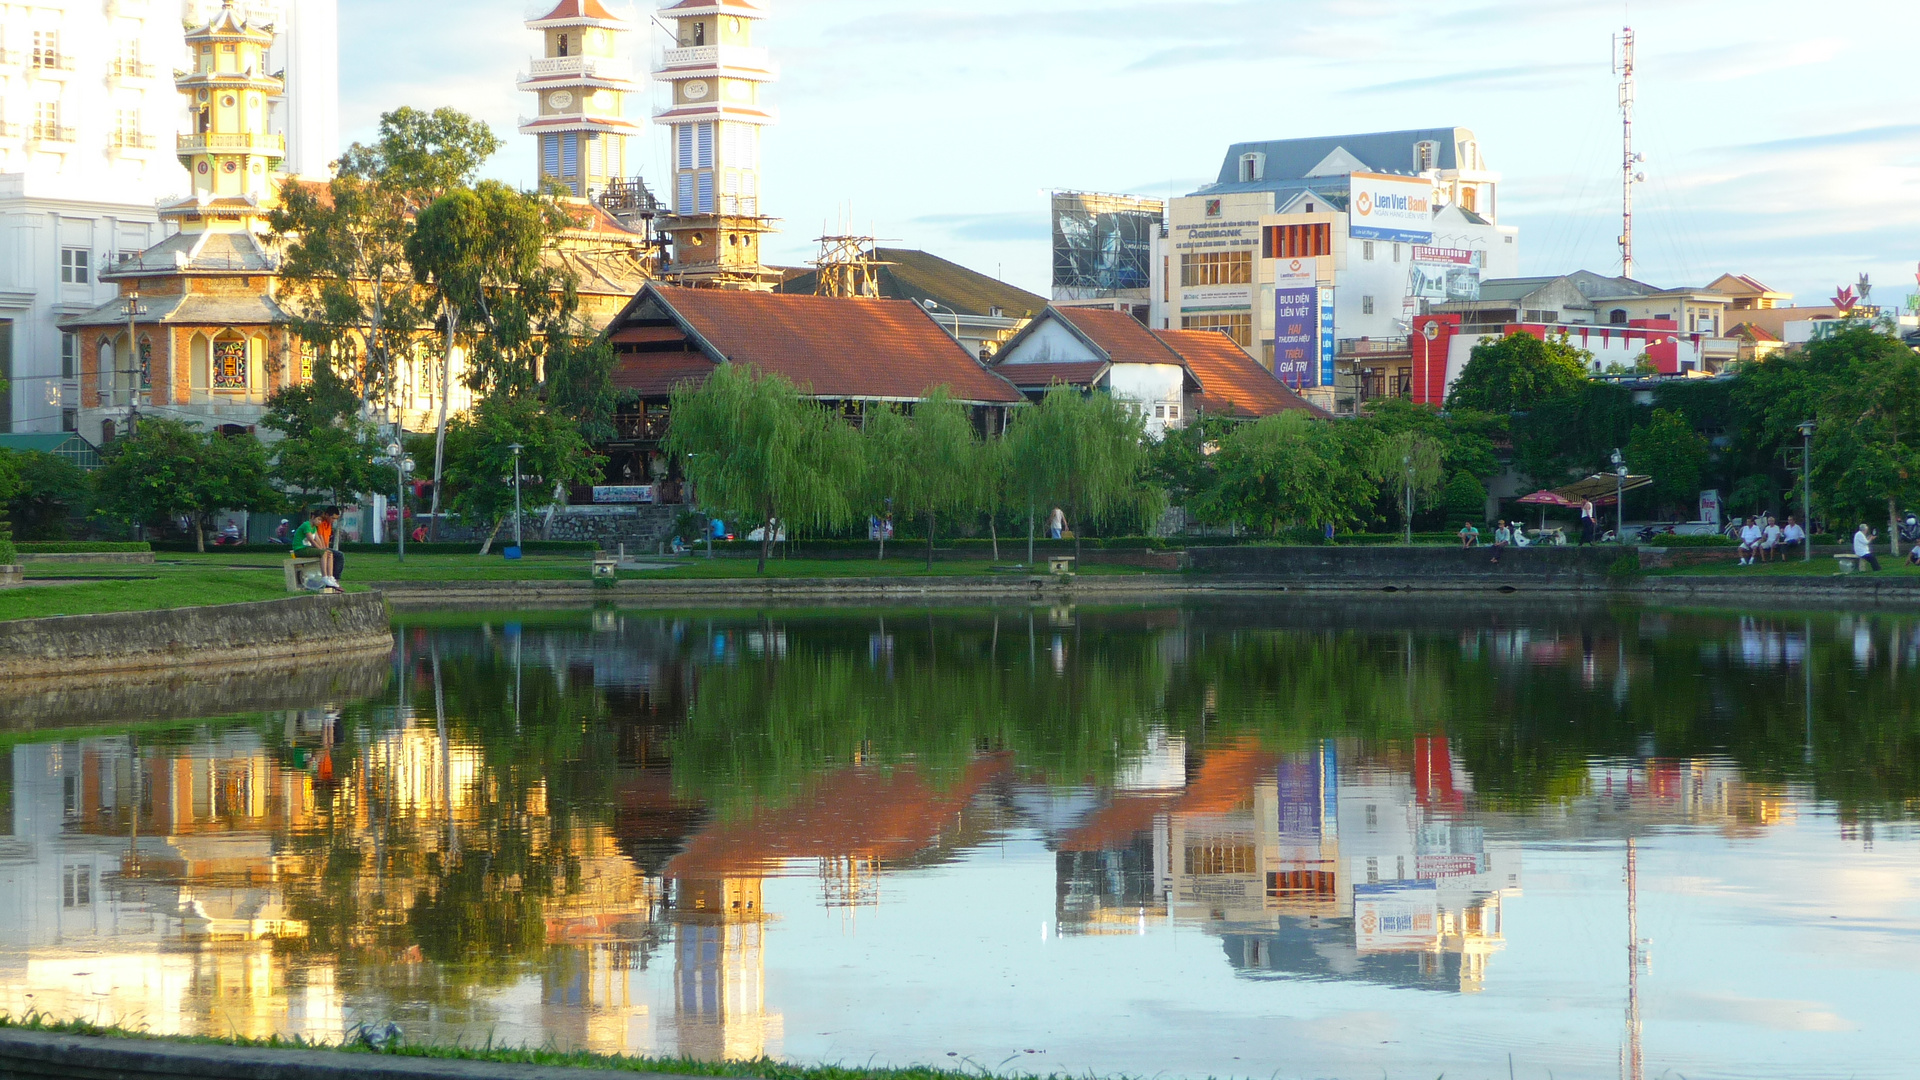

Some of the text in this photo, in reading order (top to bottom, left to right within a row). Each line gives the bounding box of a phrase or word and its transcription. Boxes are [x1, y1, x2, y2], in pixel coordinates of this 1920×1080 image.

[1421, 247, 1439, 256] LUCKY
[1439, 249, 1467, 258] WINDOWS
[1280, 294, 1294, 305] BƯU
[1295, 292, 1310, 305] ĐIỆN
[1280, 305, 1310, 318] LIÊN VIỆT
[1287, 323, 1302, 335] HAI
[1280, 359, 1308, 374] GIÁ TRỊ
